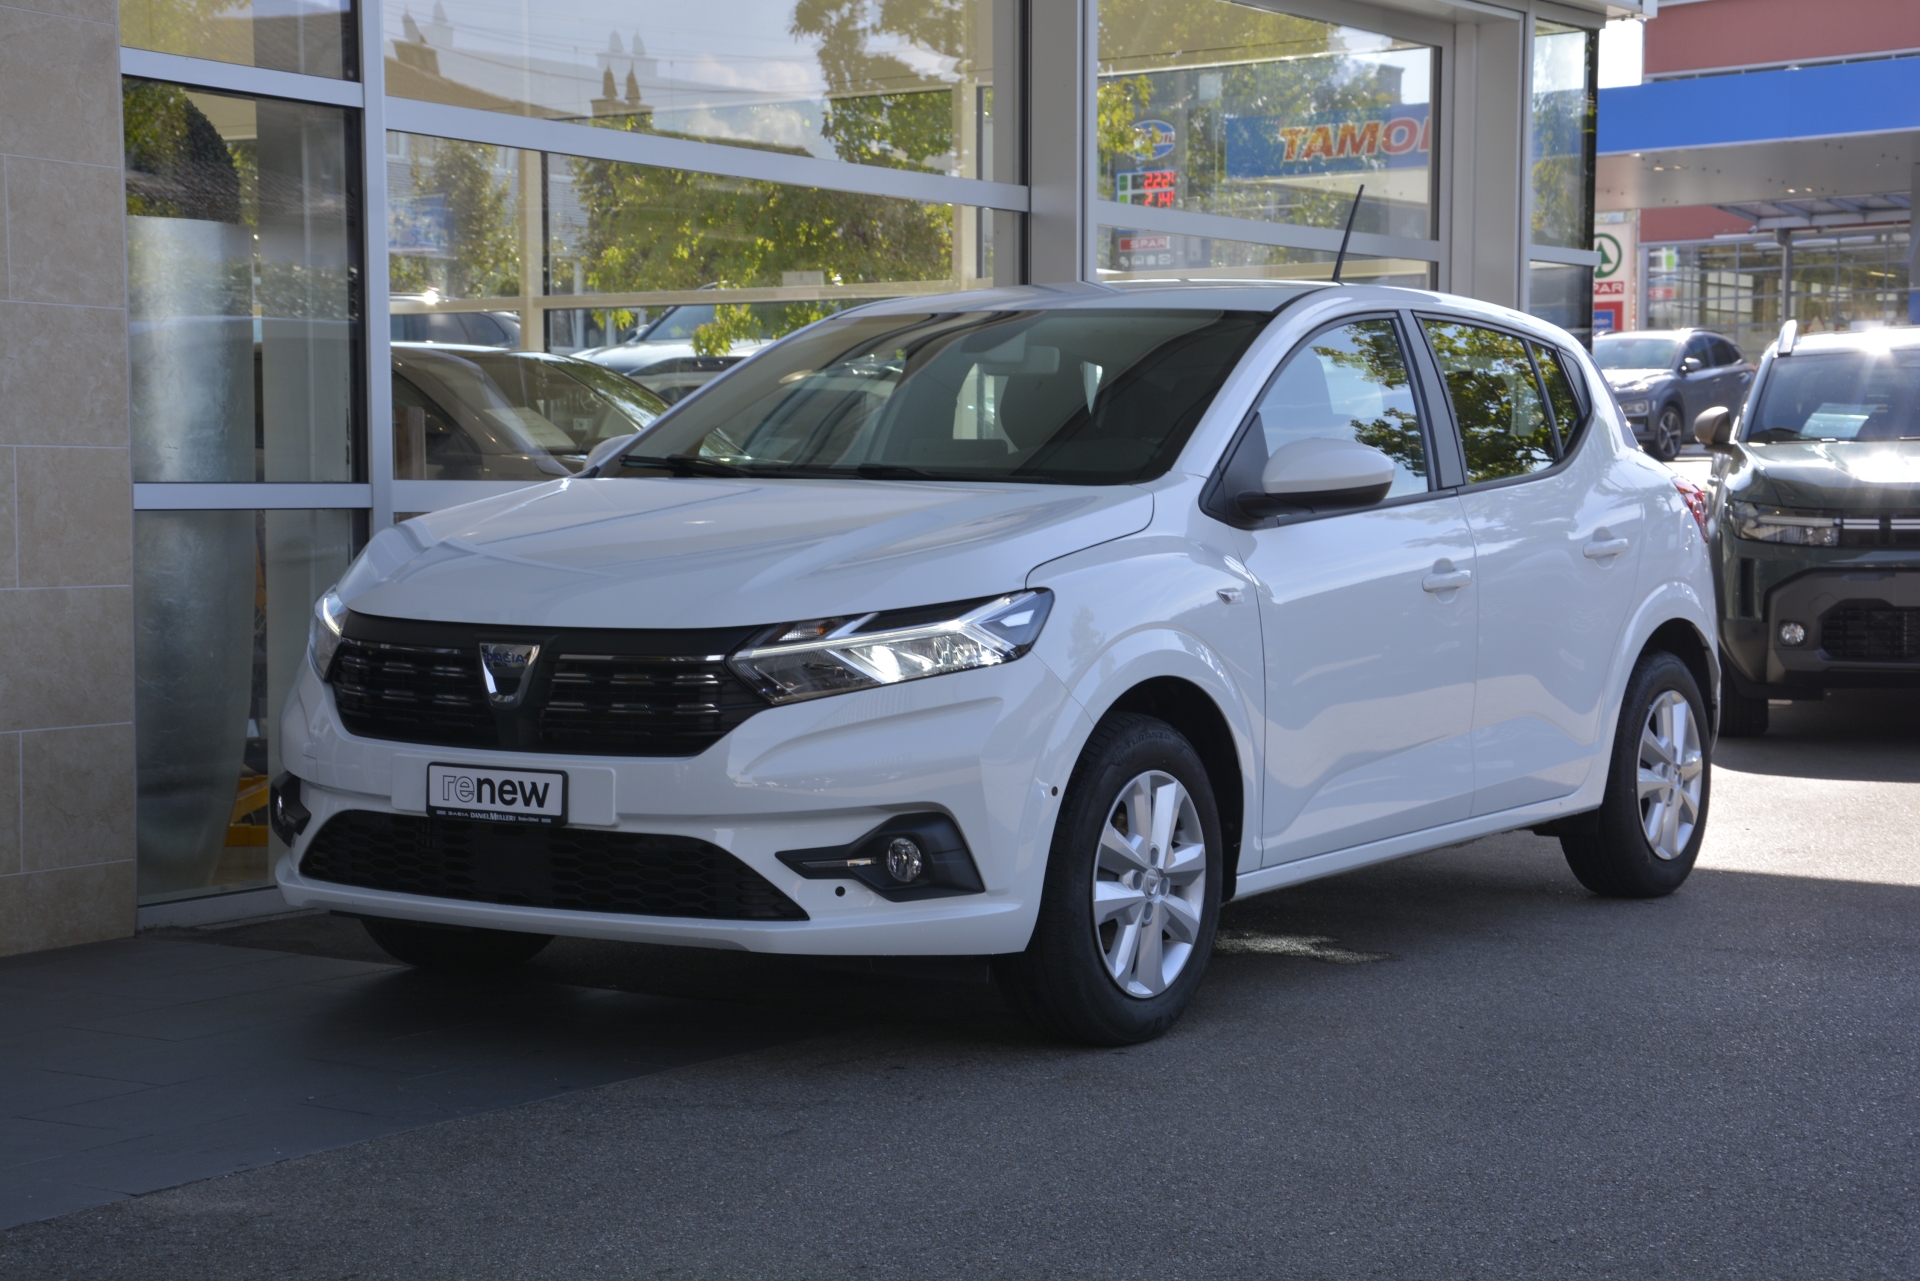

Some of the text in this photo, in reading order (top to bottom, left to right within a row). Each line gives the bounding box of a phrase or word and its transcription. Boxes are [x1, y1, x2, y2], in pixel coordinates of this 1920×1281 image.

[1129, 238, 1166, 249] SPAR
[486, 653, 525, 663] DACIA
[1125, 730, 1172, 748] TURANZA
[442, 775, 550, 809] renew
